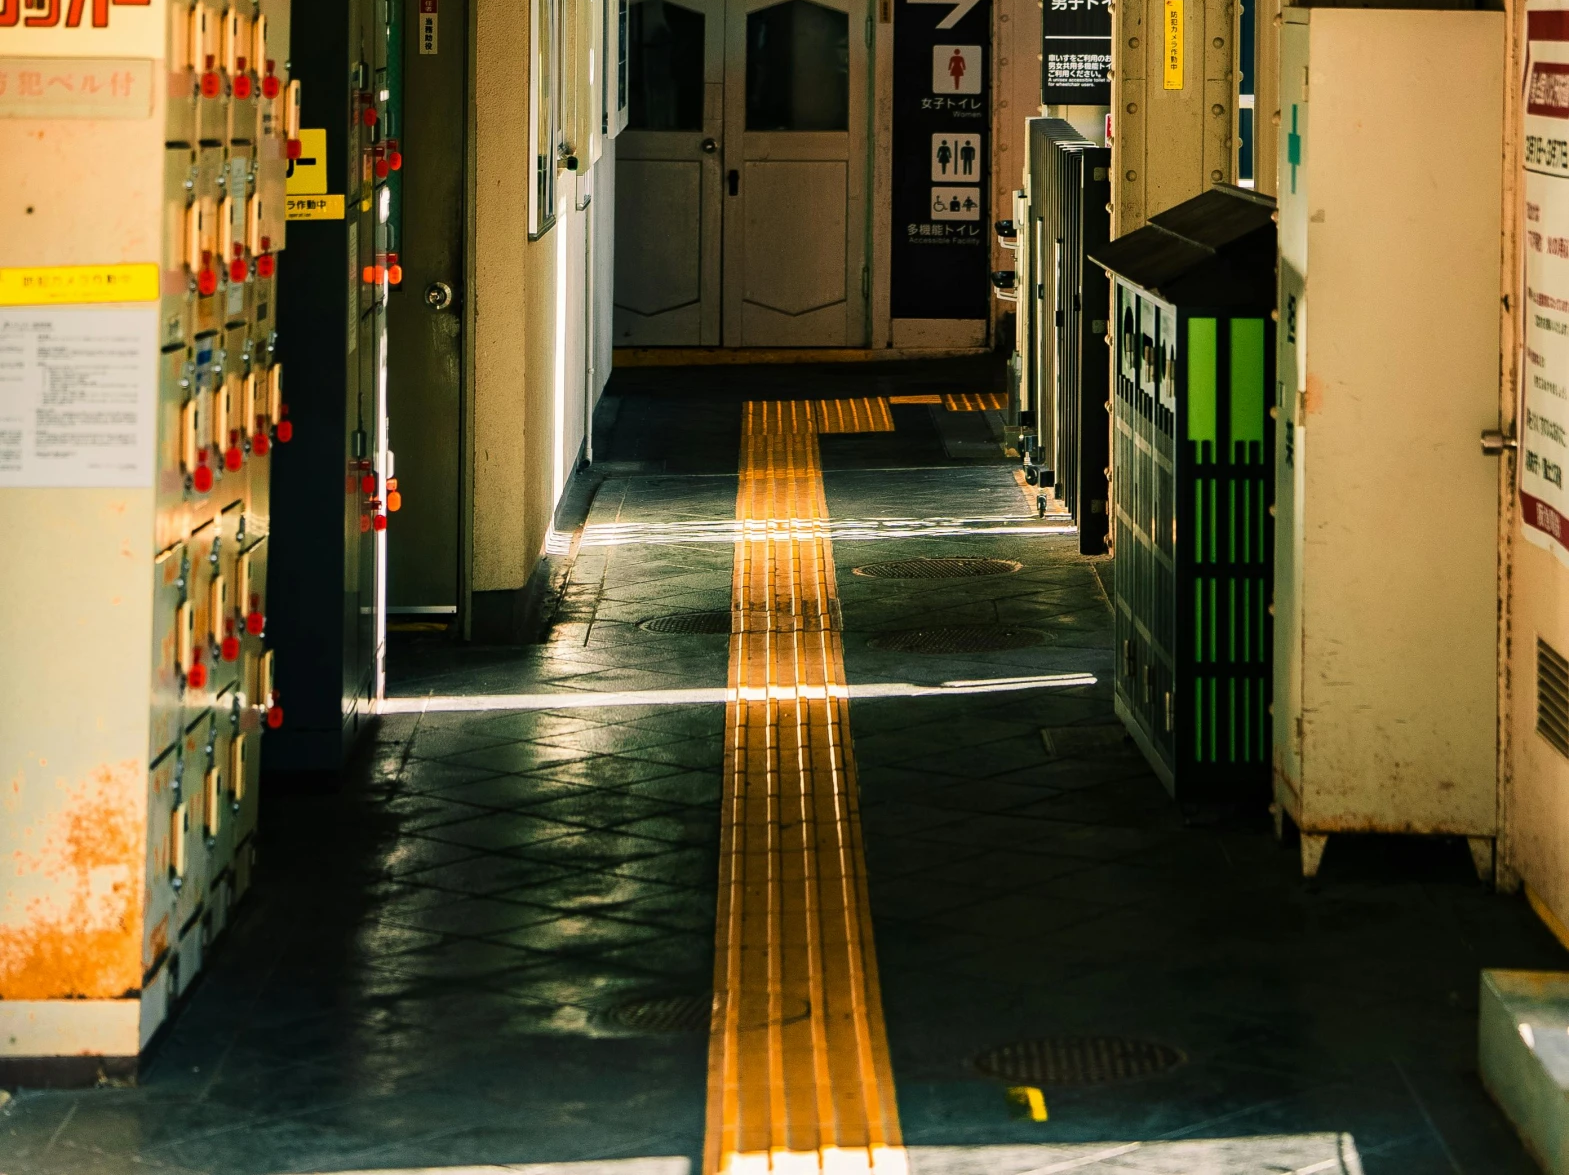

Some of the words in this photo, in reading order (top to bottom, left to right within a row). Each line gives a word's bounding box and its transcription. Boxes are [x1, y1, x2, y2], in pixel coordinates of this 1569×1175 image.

[424, 17, 433, 51] 当務助役
[1170, 11, 1178, 70] 防犯カメラ作動中
[1048, 70, 1101, 78] ご利用ください。
[0, 70, 135, 97] 犯ベル付
[921, 98, 982, 110] 女子トイレ
[953, 111, 982, 119] Women
[907, 223, 980, 236] 多機能トイレ
[953, 237, 980, 245] Facility
